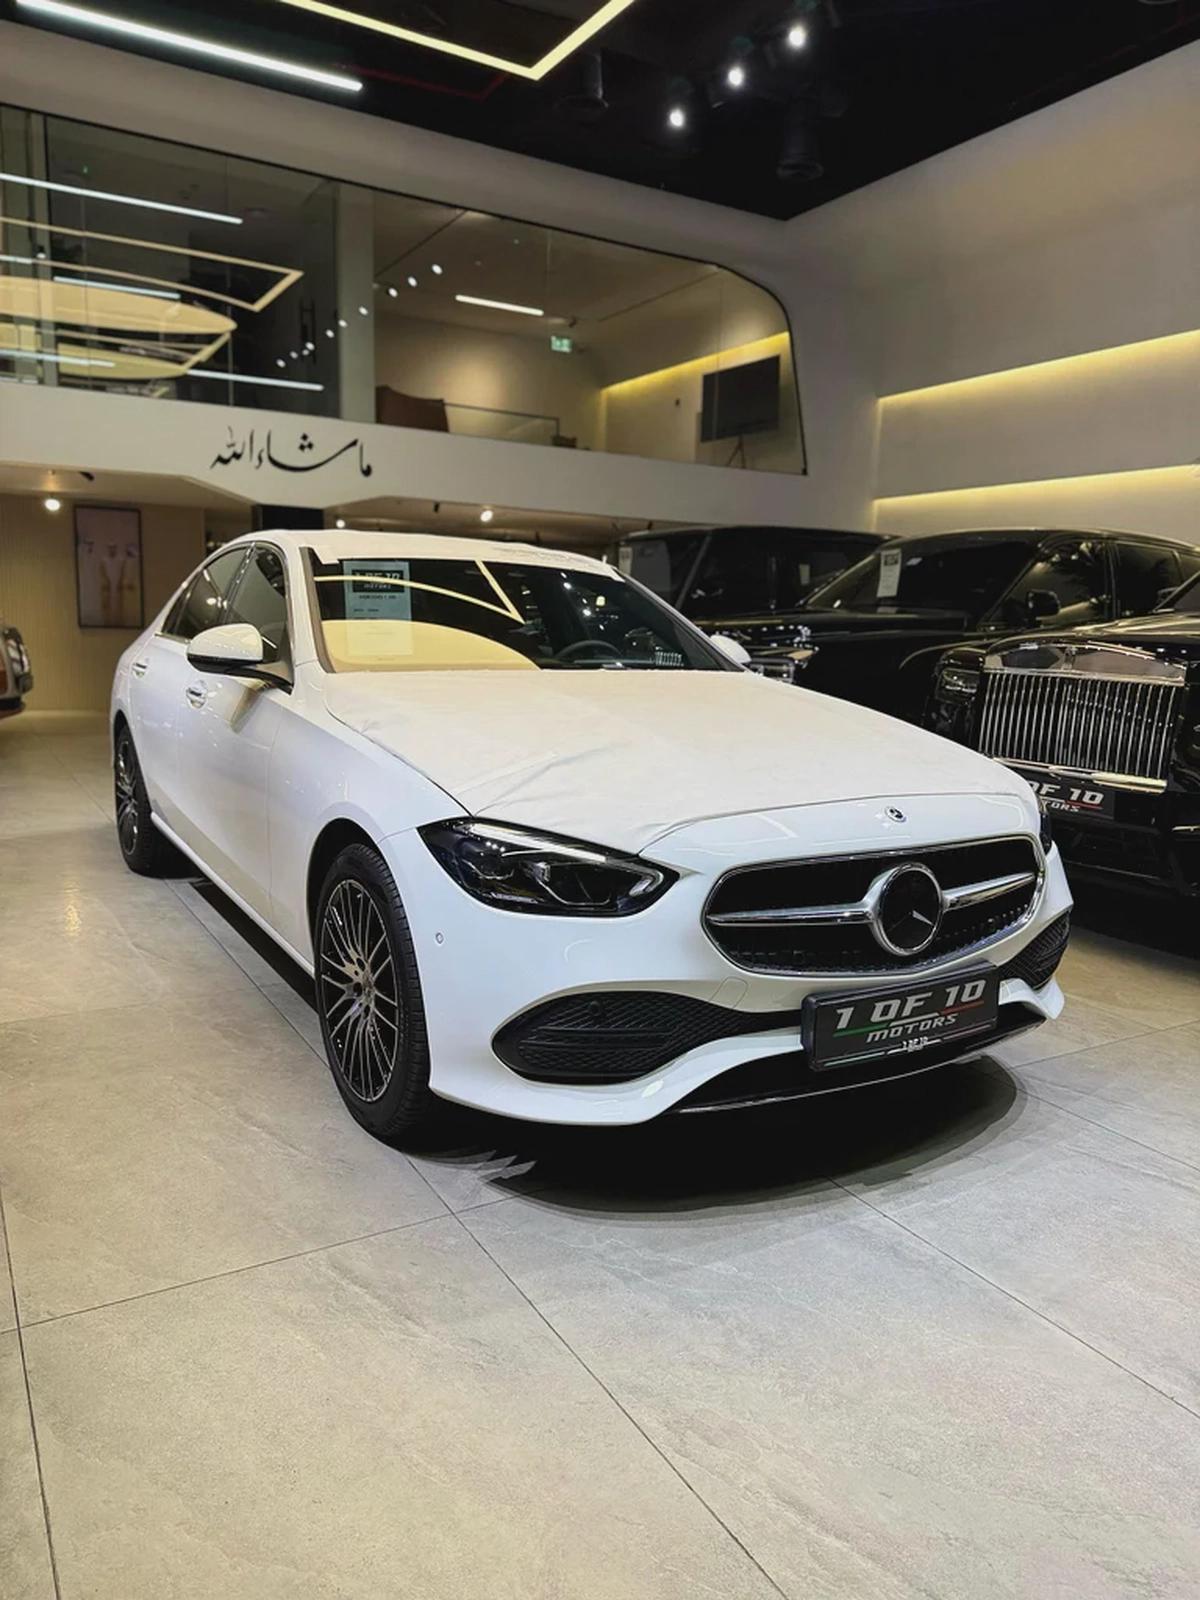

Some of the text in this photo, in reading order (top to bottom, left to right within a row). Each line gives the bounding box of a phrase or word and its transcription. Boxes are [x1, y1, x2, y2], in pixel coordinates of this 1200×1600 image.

[1069, 787, 1105, 805] 10
[836, 979, 987, 1030] 1 OF 10
[866, 1013, 958, 1043] MOTORS
